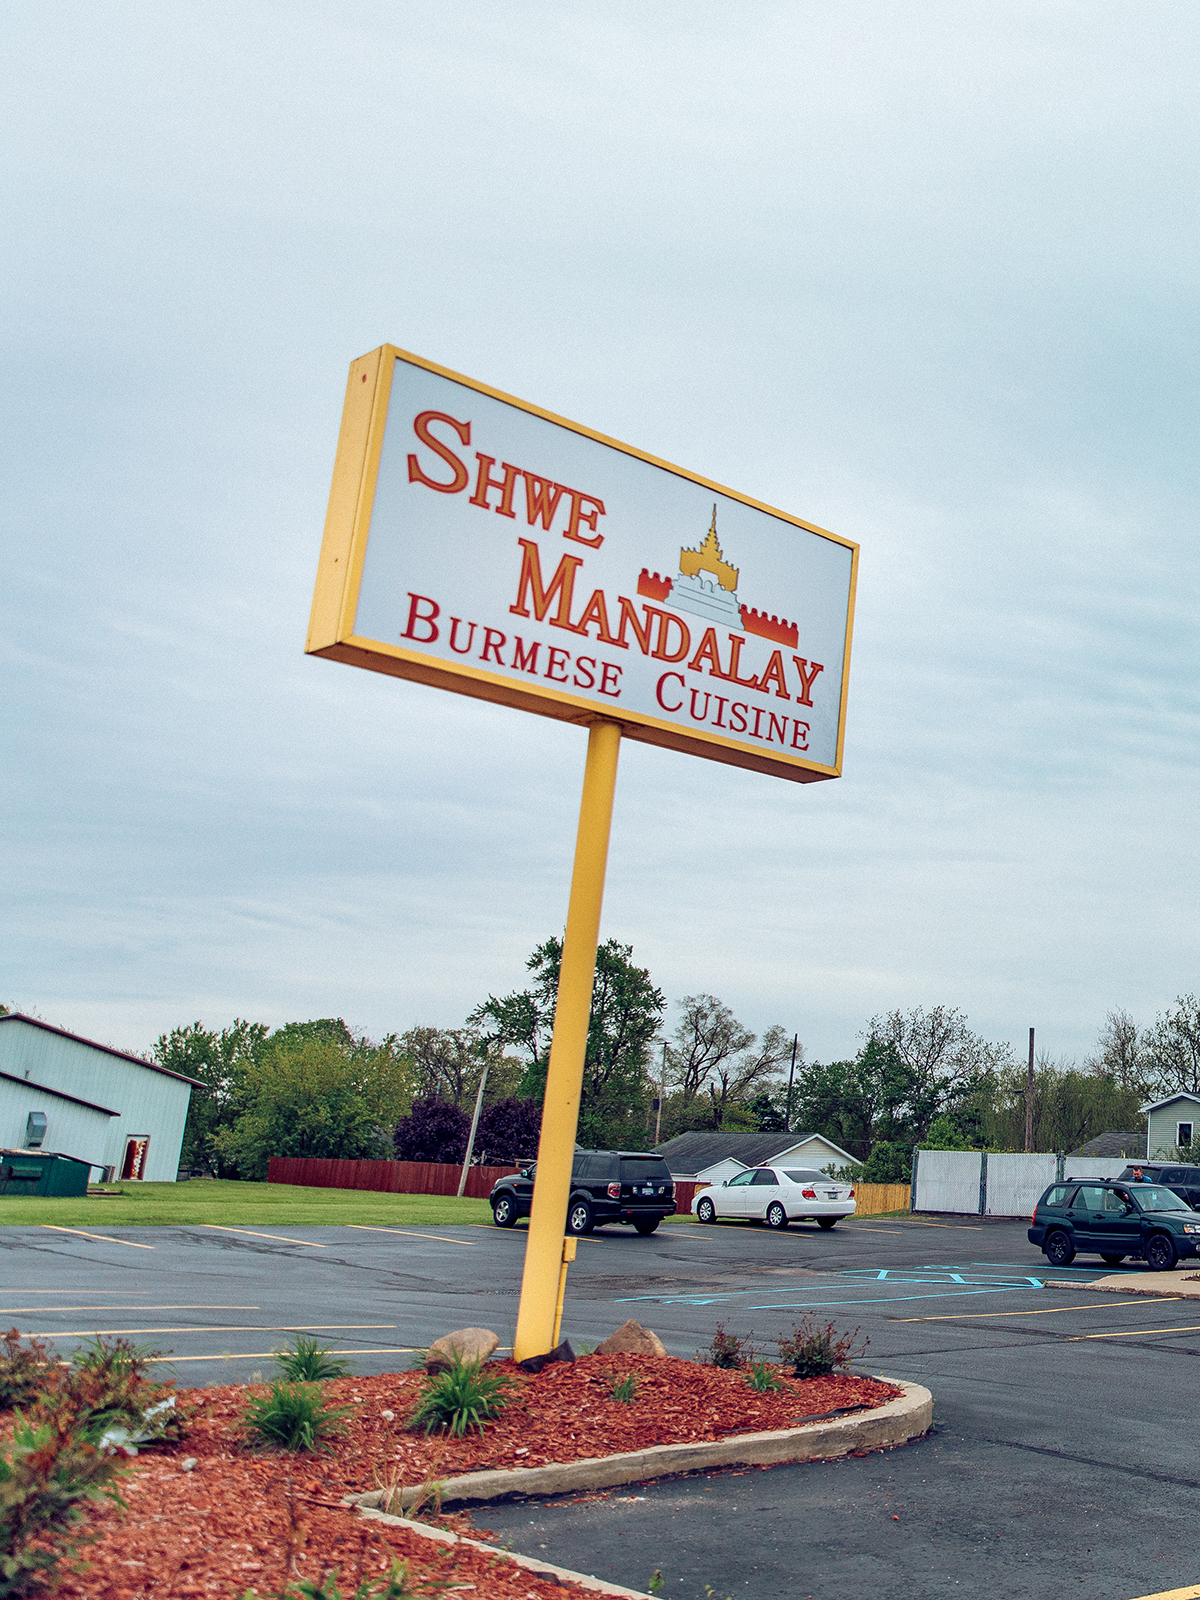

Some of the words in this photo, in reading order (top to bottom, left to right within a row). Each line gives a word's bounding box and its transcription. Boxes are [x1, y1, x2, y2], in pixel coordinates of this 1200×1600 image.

[406, 410, 607, 551] SHWE
[400, 592, 624, 699] BURMESE
[655, 670, 811, 751] CUISINE
[509, 537, 825, 708] MANDALAY
